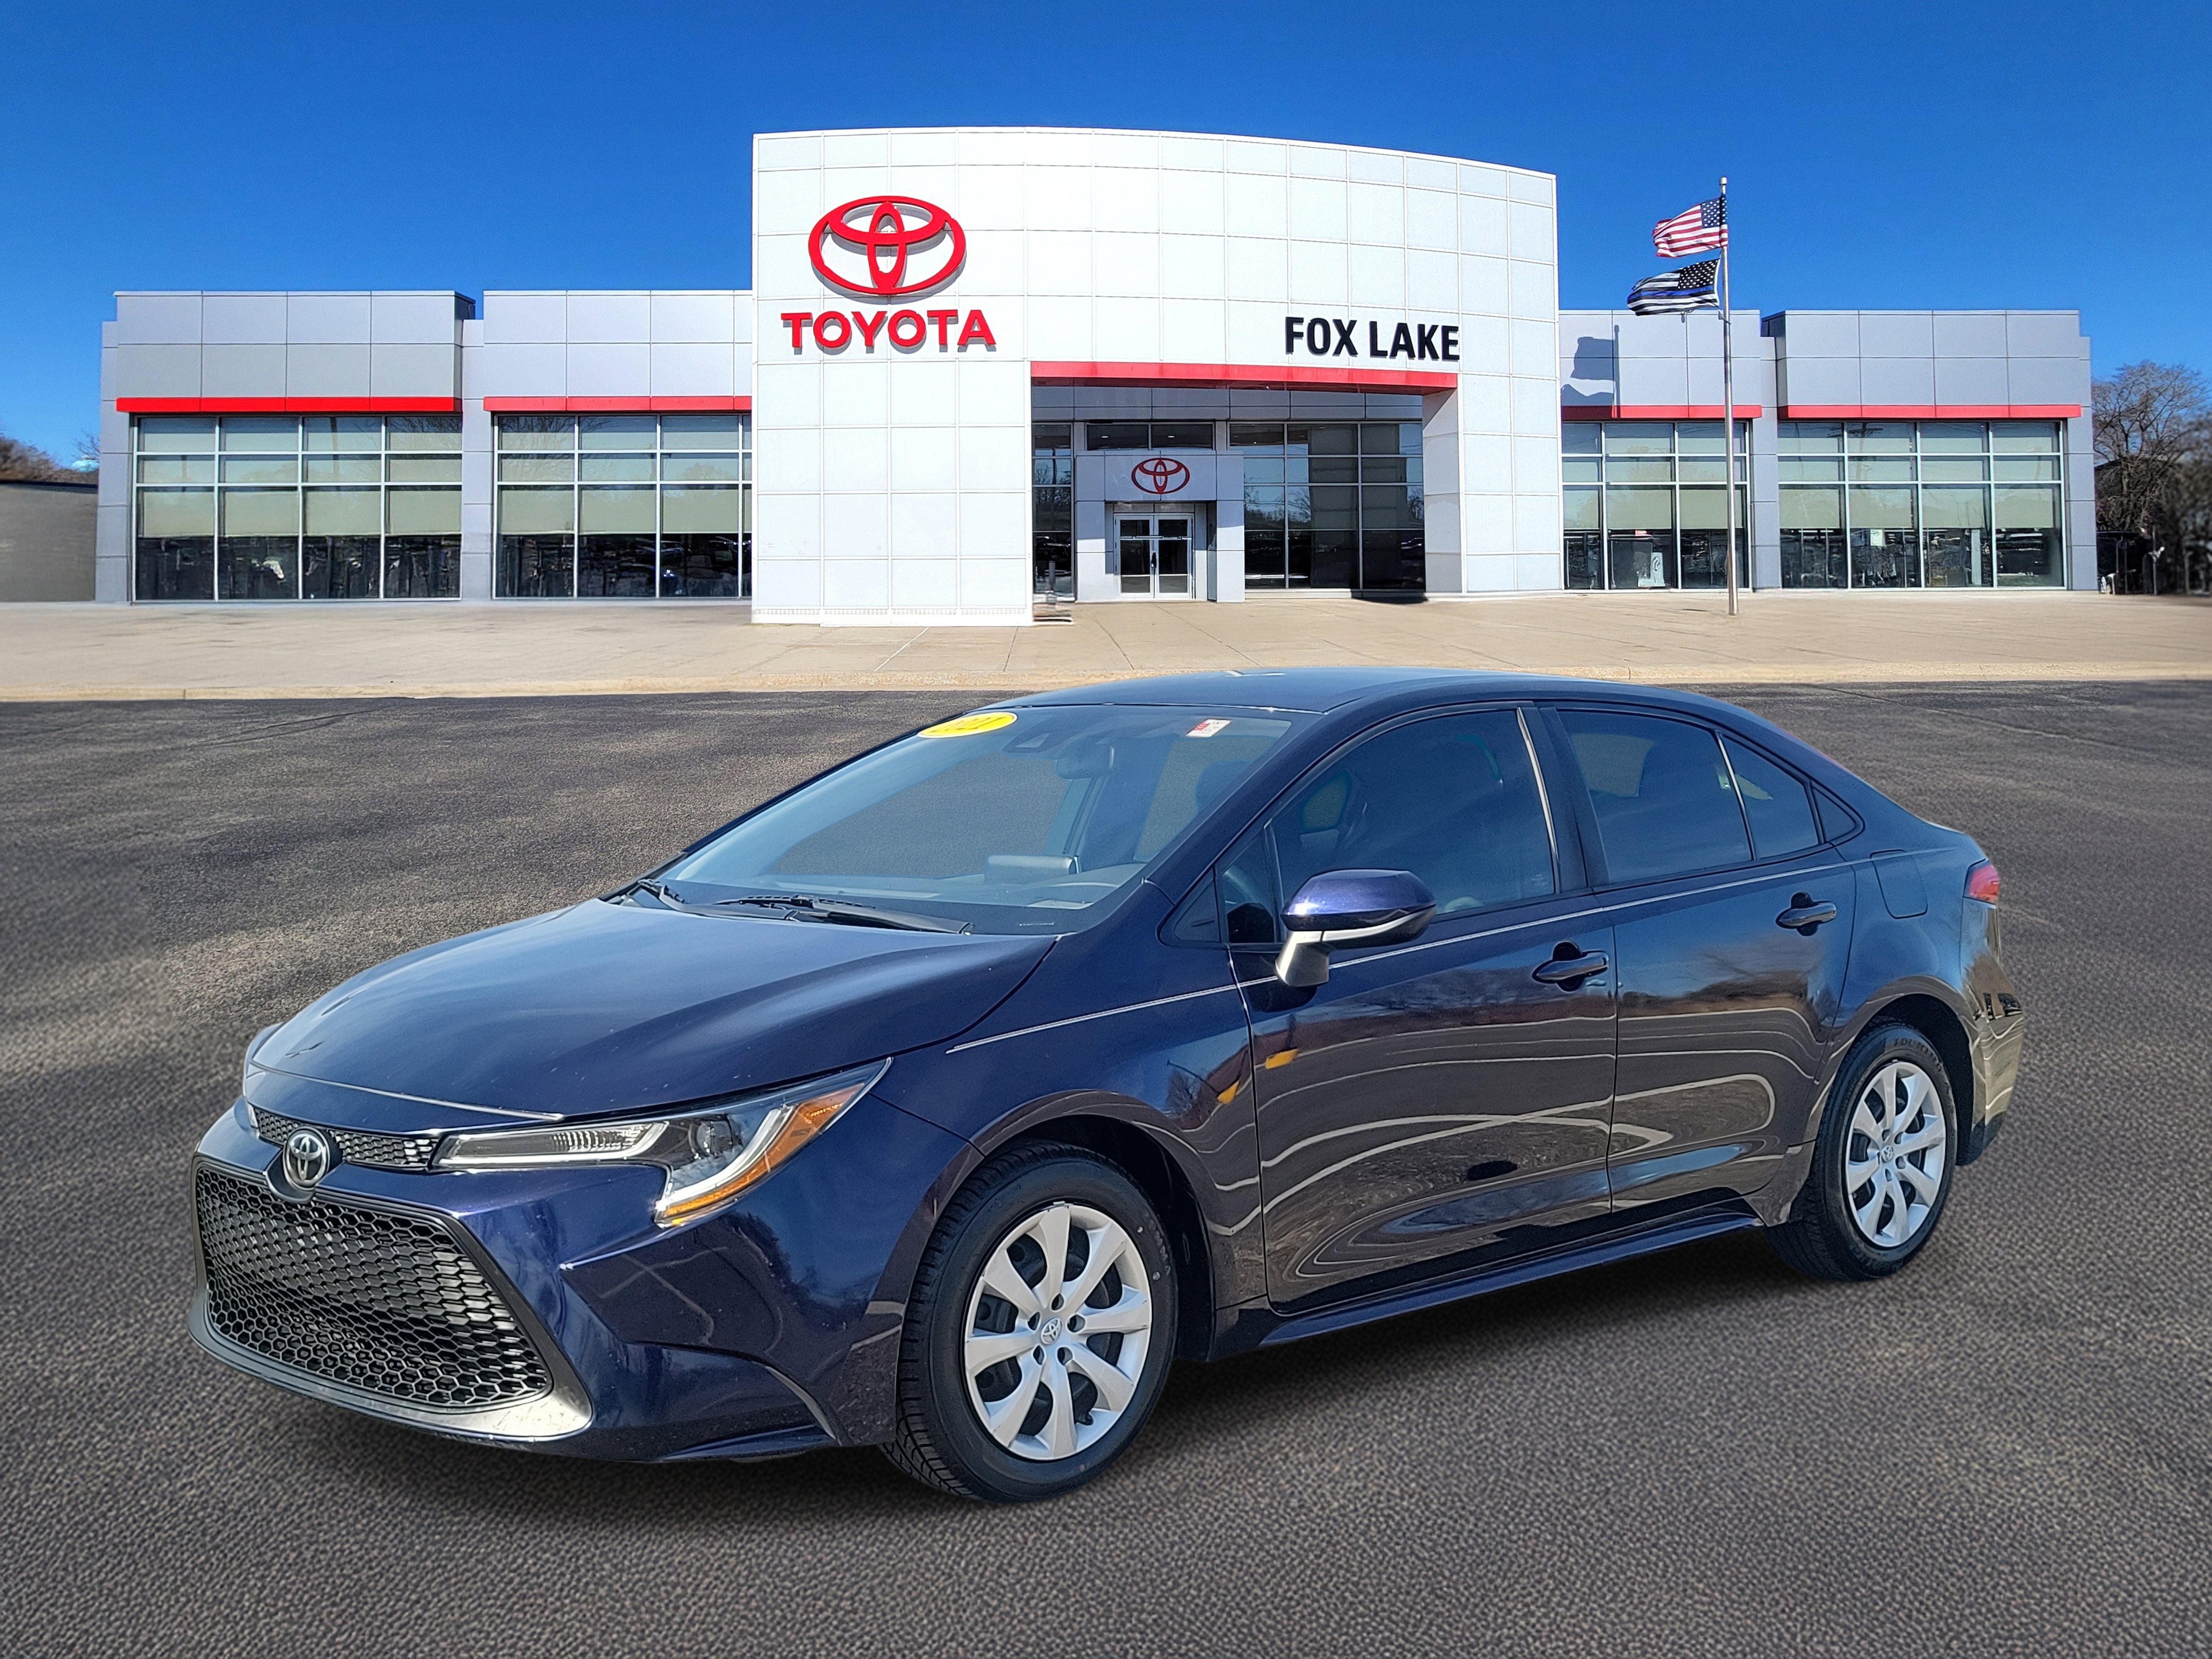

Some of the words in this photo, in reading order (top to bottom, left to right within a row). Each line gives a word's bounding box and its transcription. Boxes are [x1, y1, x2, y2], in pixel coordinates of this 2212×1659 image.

[781, 309, 996, 351] TOYOTA
[1285, 316, 1358, 356] FOX
[1369, 321, 1460, 360] LAKE
